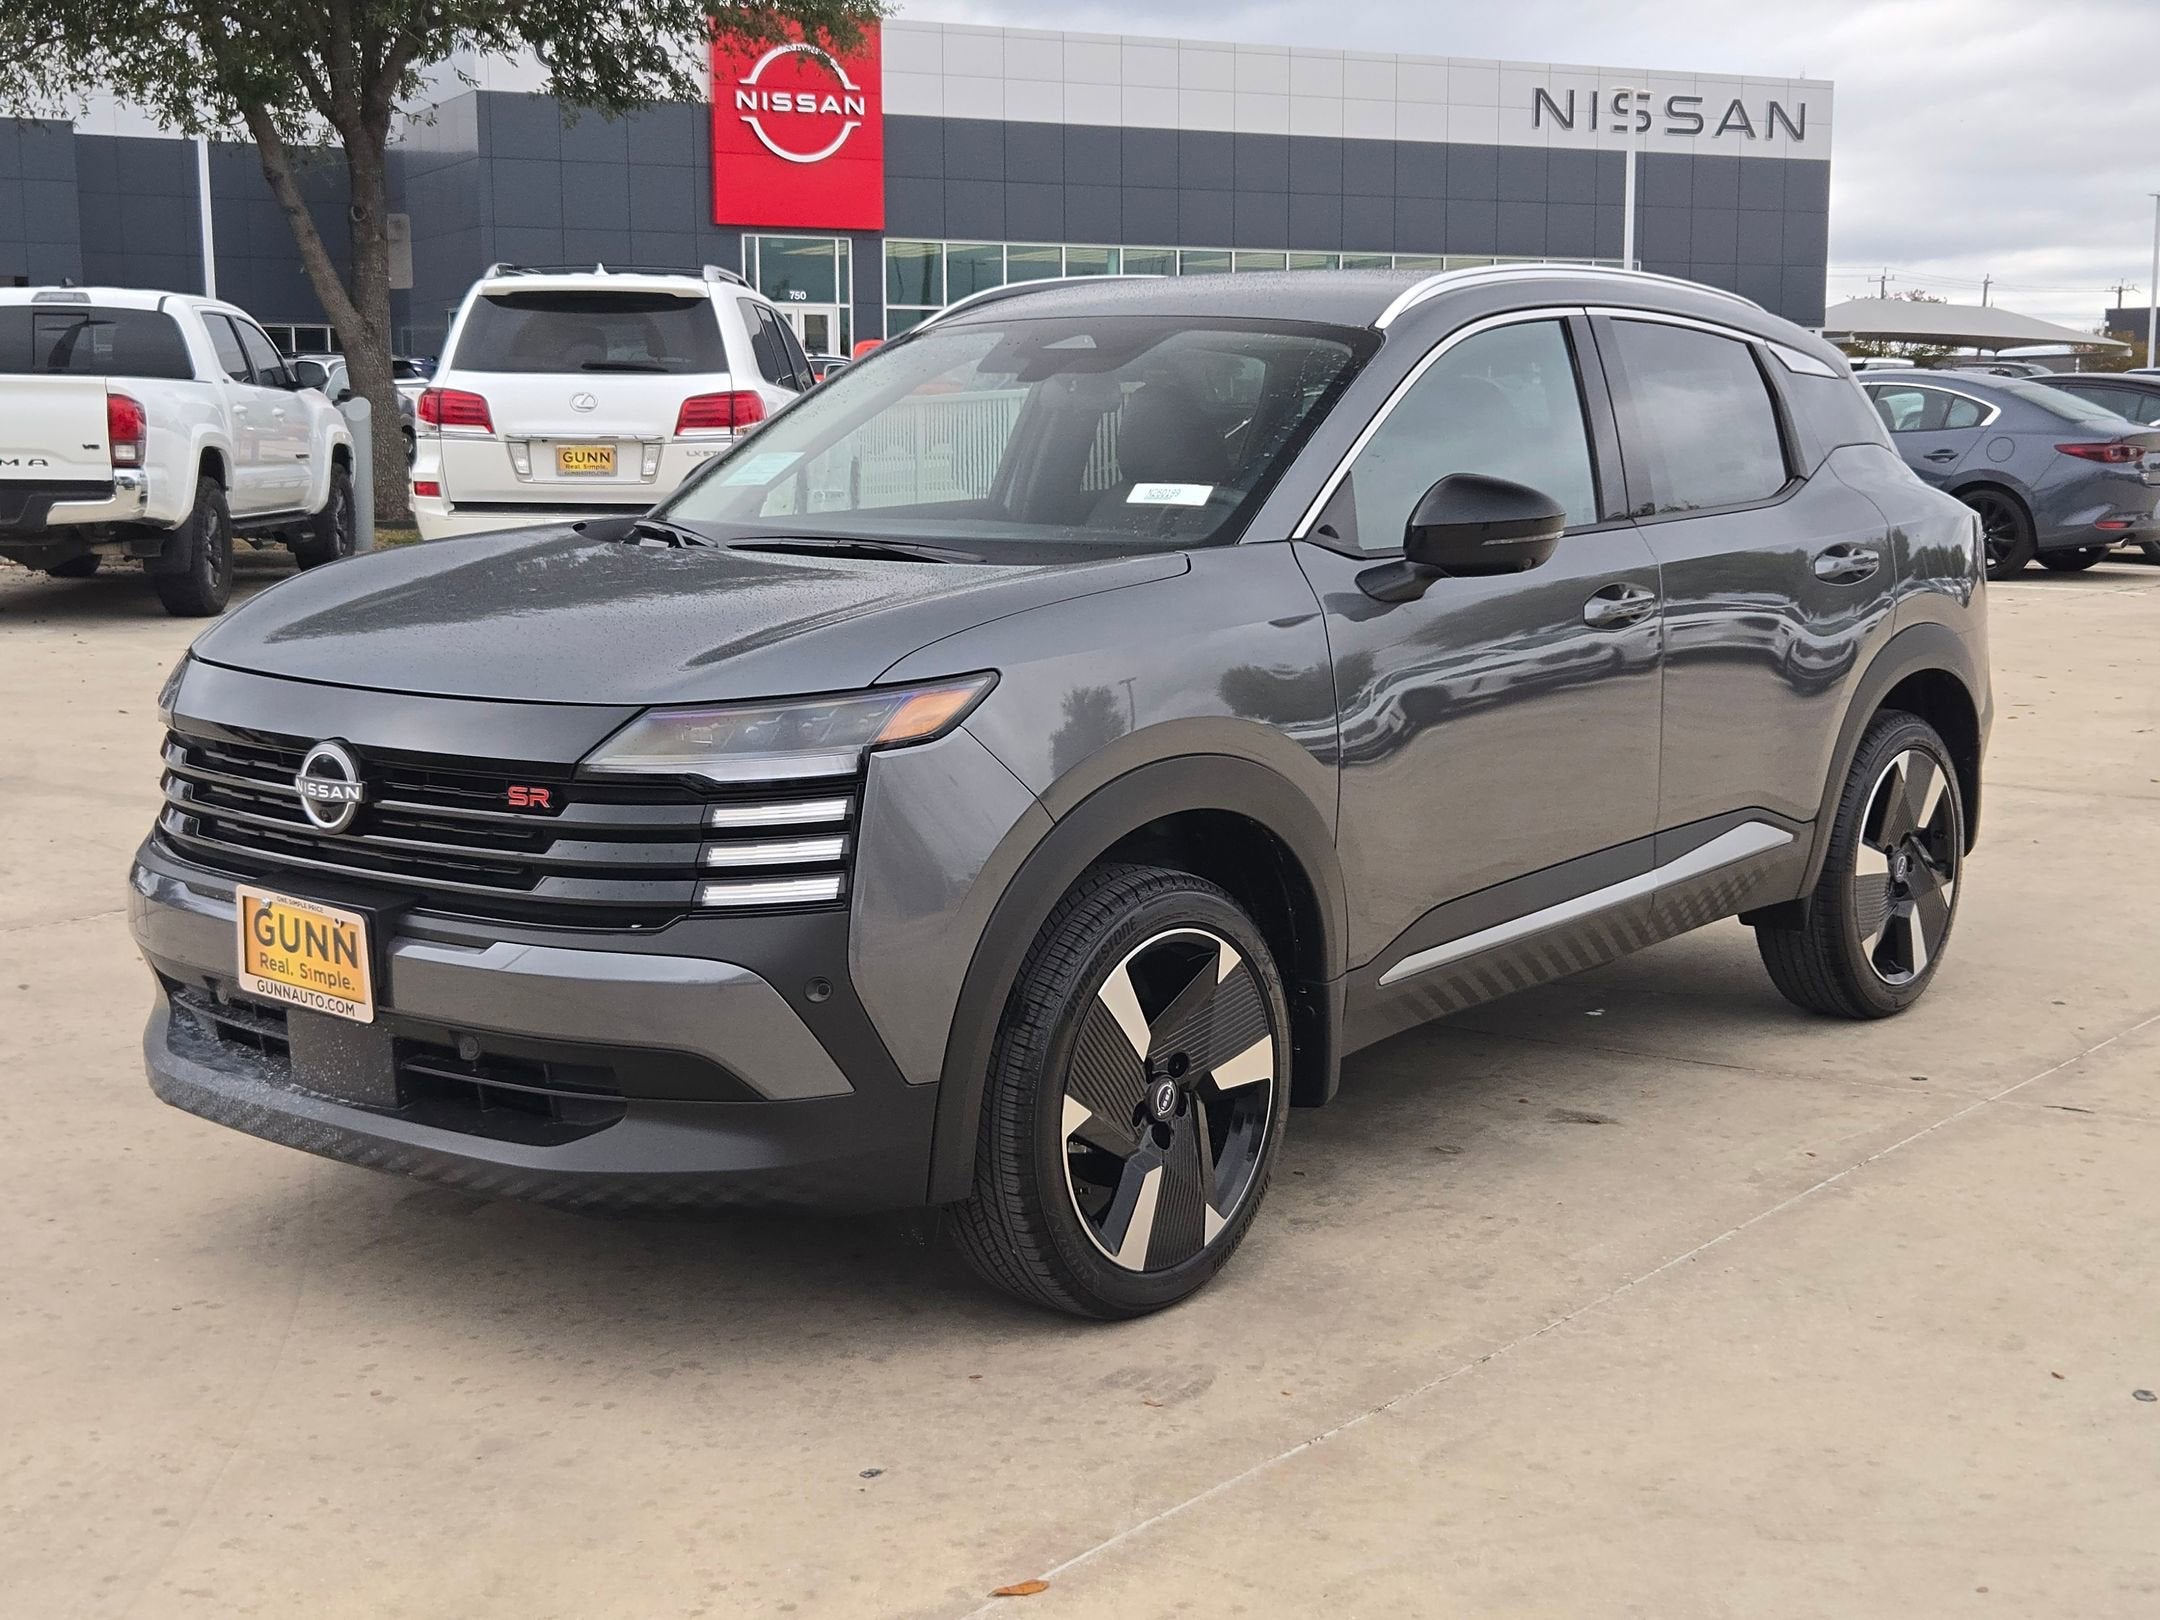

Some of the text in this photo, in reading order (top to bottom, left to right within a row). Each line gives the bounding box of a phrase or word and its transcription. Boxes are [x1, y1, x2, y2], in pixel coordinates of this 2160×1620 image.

[735, 89, 865, 116] NISSAN
[1532, 87, 1806, 142] NISSAN
[789, 290, 807, 300] 750
[562, 451, 611, 463] GUNN
[294, 779, 360, 801] NISSAN
[507, 785, 551, 809] SR
[254, 908, 358, 969] GUNN
[260, 952, 294, 977] Real.
[257, 979, 356, 1017] GUNNAUTO.COM
